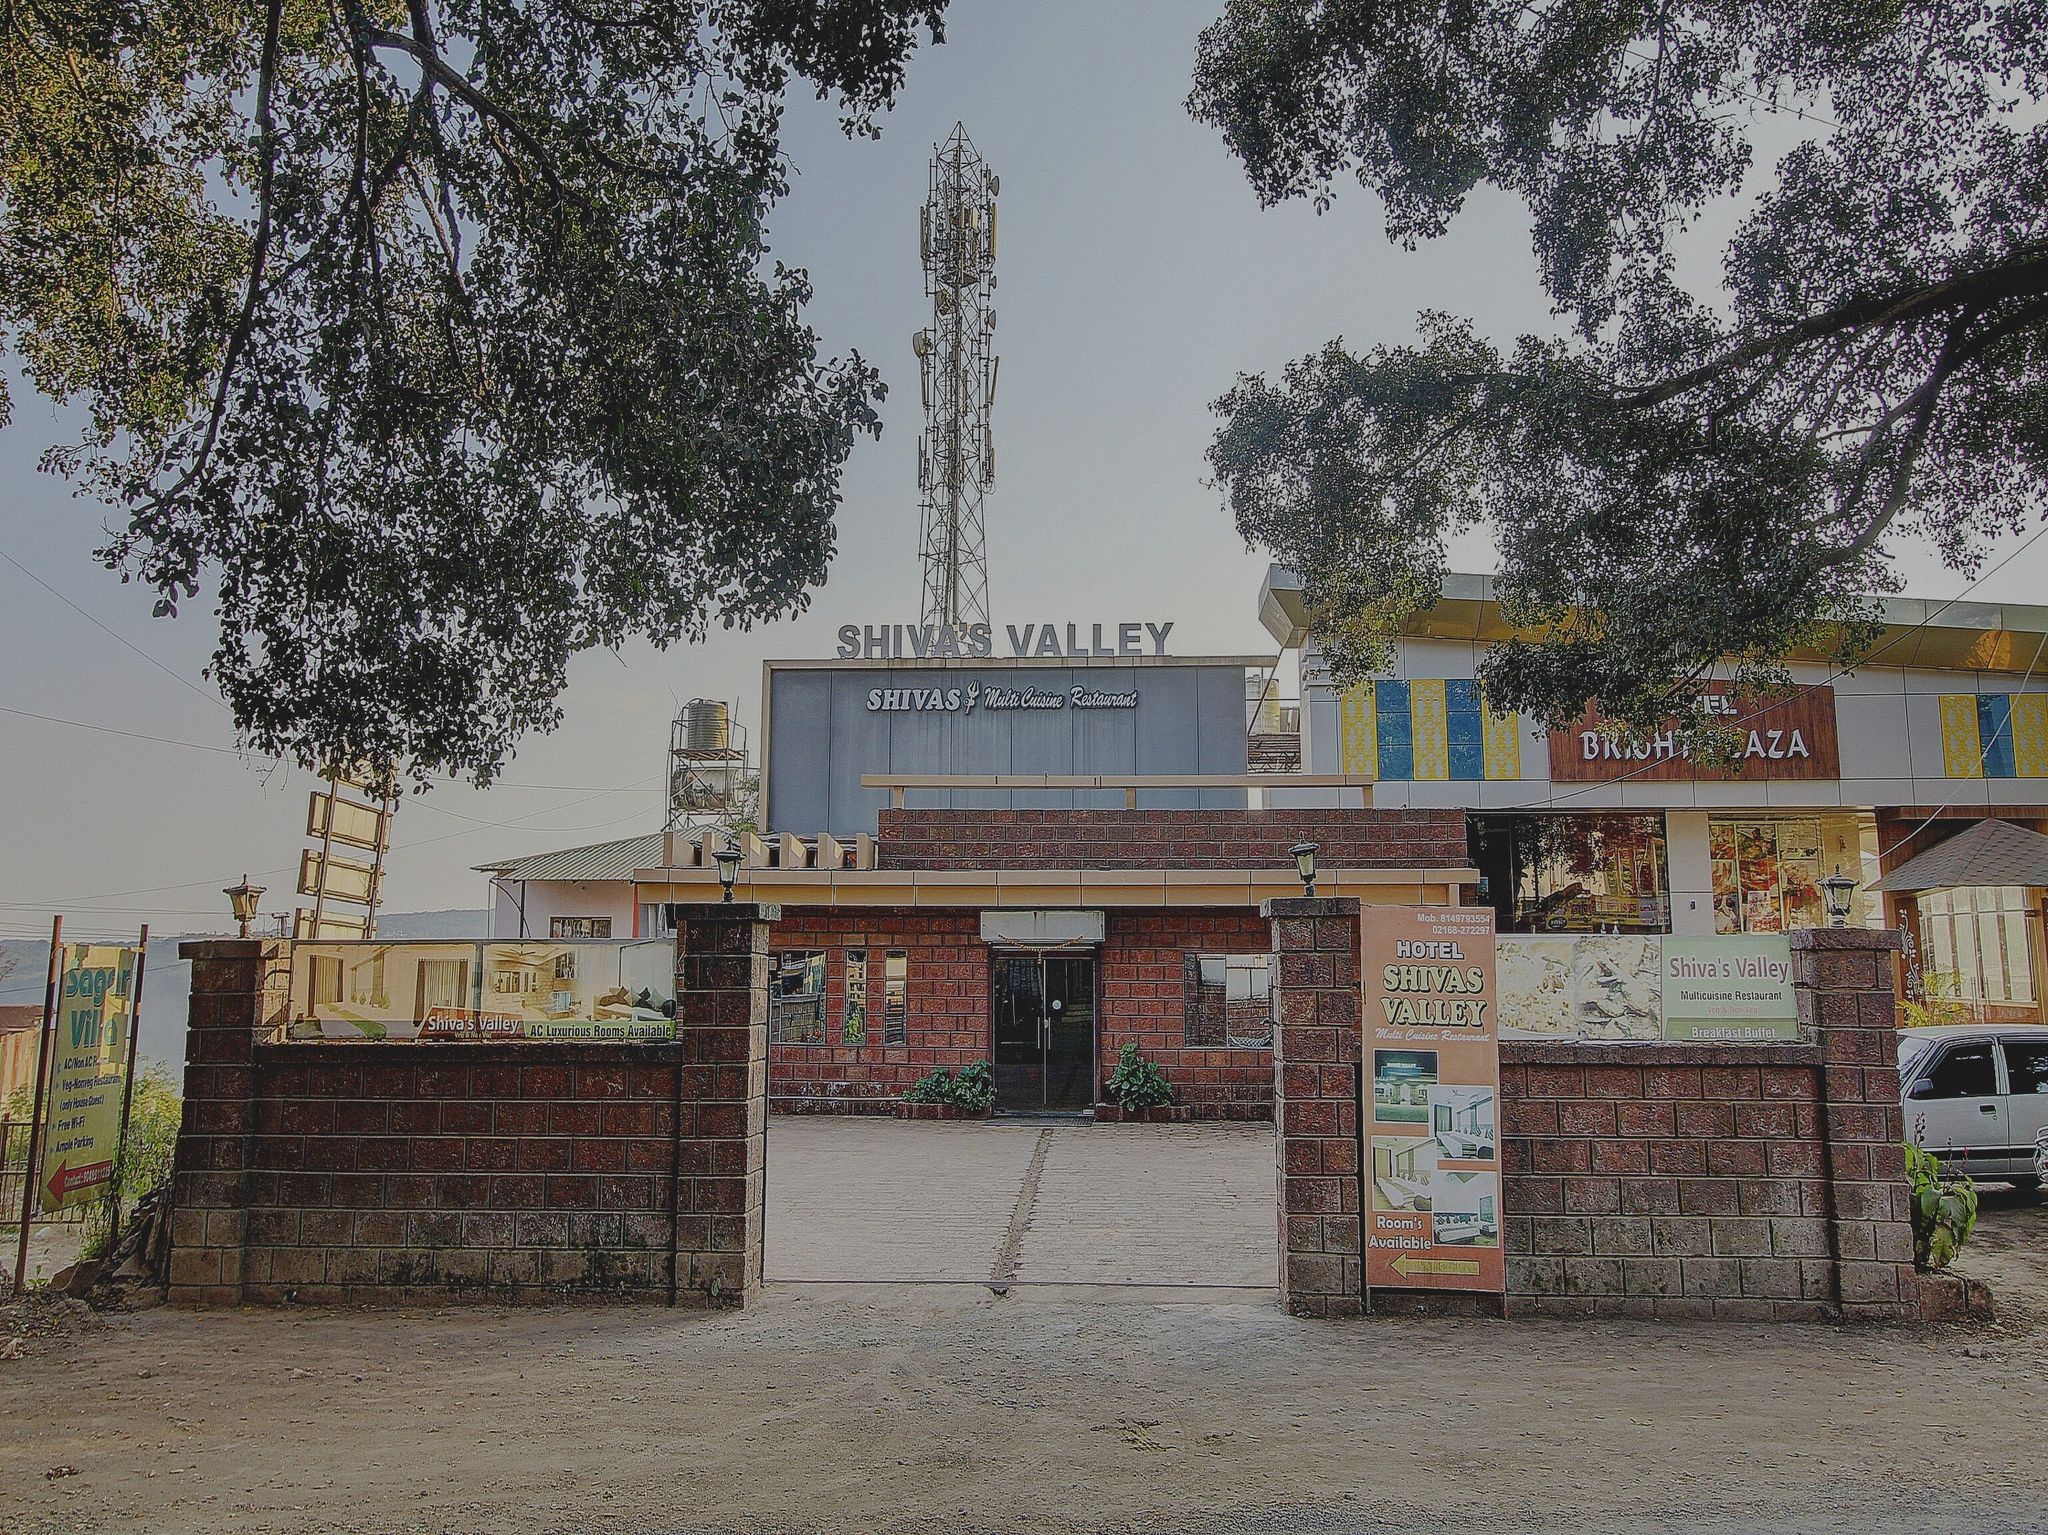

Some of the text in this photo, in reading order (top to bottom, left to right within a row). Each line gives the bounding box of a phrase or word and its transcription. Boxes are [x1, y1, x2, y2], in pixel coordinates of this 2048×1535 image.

[837, 621, 1175, 659] SHIVA'S VALLEY
[866, 685, 1139, 712] SHIVAS Multi Cuisine Restaurant
[1579, 729, 1691, 760] BRIGH
[1417, 913, 1438, 922] Mob.
[1396, 940, 1465, 959] HOTEL
[1383, 964, 1484, 994] SHIVAS
[1669, 956, 1789, 984] Shiva's Valley
[1680, 990, 1782, 1001] Multicuisine Restaurant
[1380, 997, 1487, 1027] VALLEY
[428, 1012, 520, 1035] Shiva's Valley
[530, 1024, 672, 1038] AC Luxurious Rooms Available
[1691, 1026, 1777, 1039] Breakfast Buffet
[1375, 1027, 1490, 1042] Multi Cuisine Restaurant
[1376, 1215, 1423, 1230] Room's
[1368, 1234, 1433, 1251] Available
